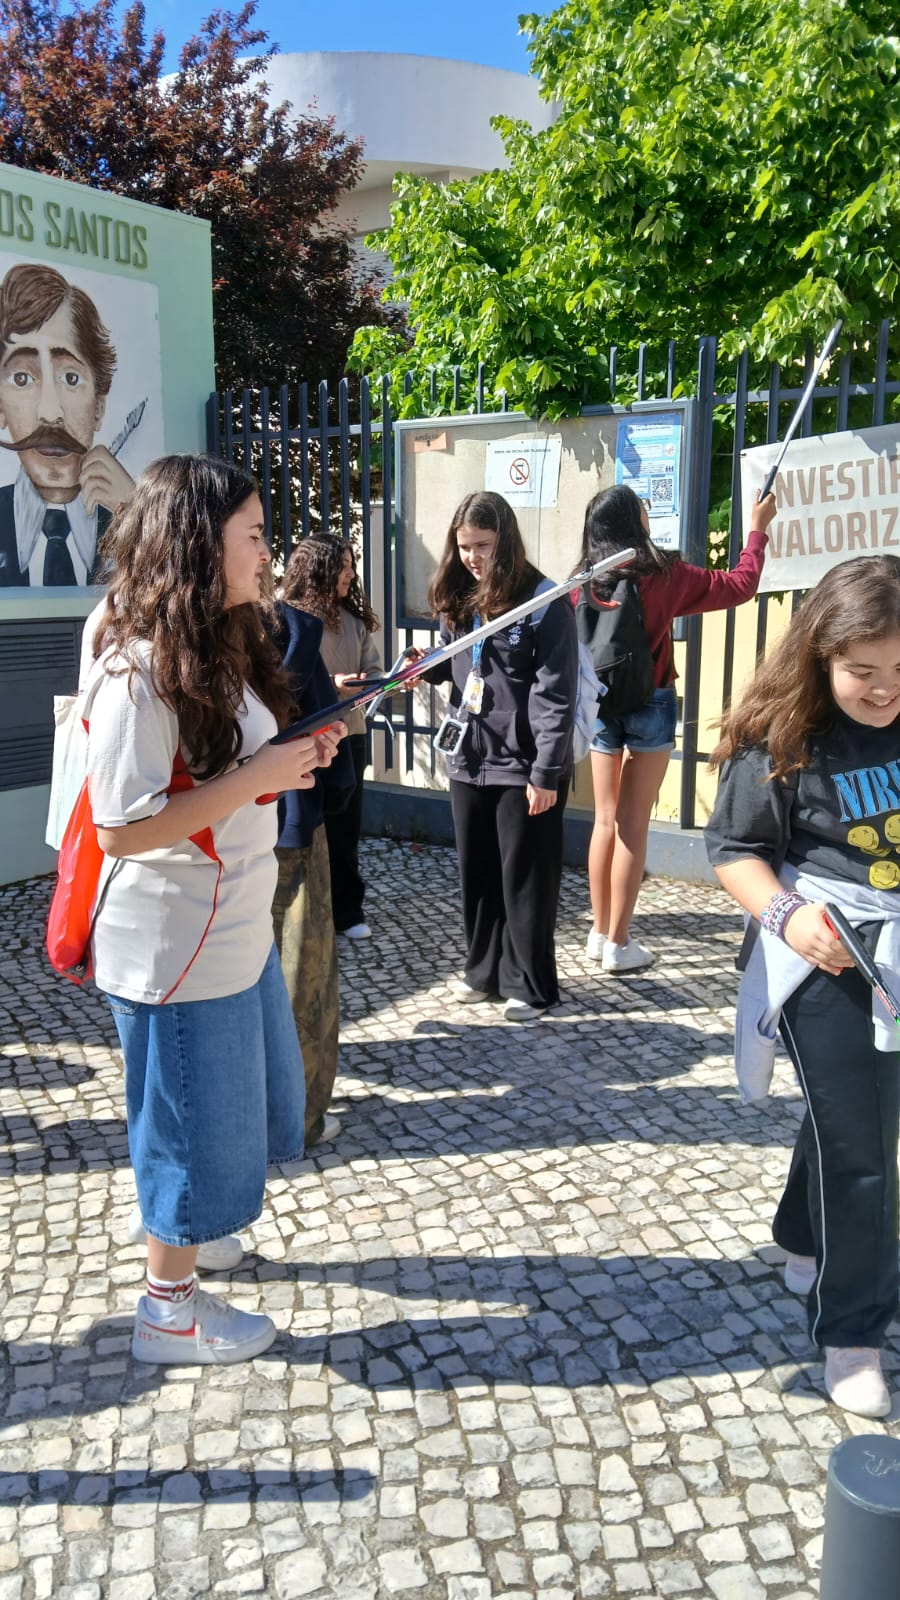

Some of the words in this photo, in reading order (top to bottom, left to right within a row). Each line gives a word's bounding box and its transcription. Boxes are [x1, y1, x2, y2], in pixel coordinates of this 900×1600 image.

[45, 201, 148, 269] SANTOS
[764, 455, 900, 509] NVESTI
[766, 507, 900, 559] VALORIZ
